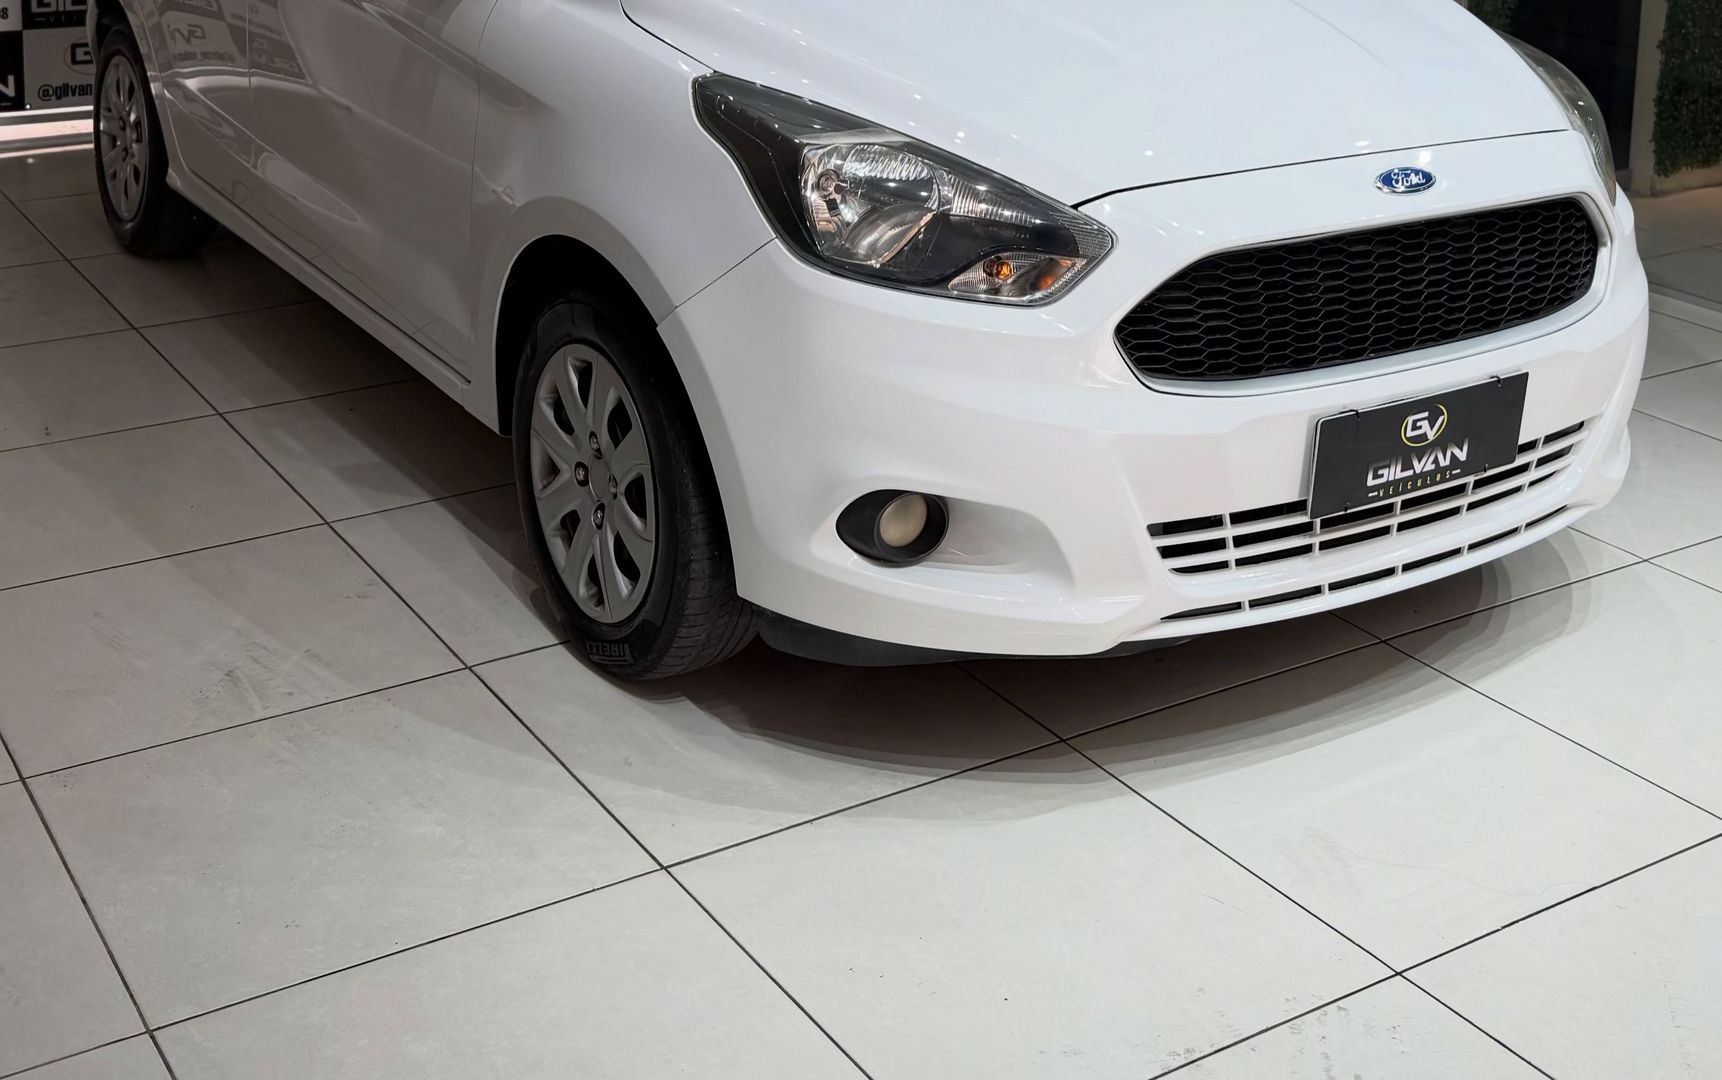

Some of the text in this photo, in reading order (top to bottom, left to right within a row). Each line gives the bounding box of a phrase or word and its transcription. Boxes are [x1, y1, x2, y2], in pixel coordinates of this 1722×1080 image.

[38, 84, 92, 101] @gilvan
[1391, 168, 1426, 190] Ford
[1406, 411, 1444, 440] GV
[1367, 438, 1469, 487] GILVAN
[586, 640, 634, 665] PIRELLI
